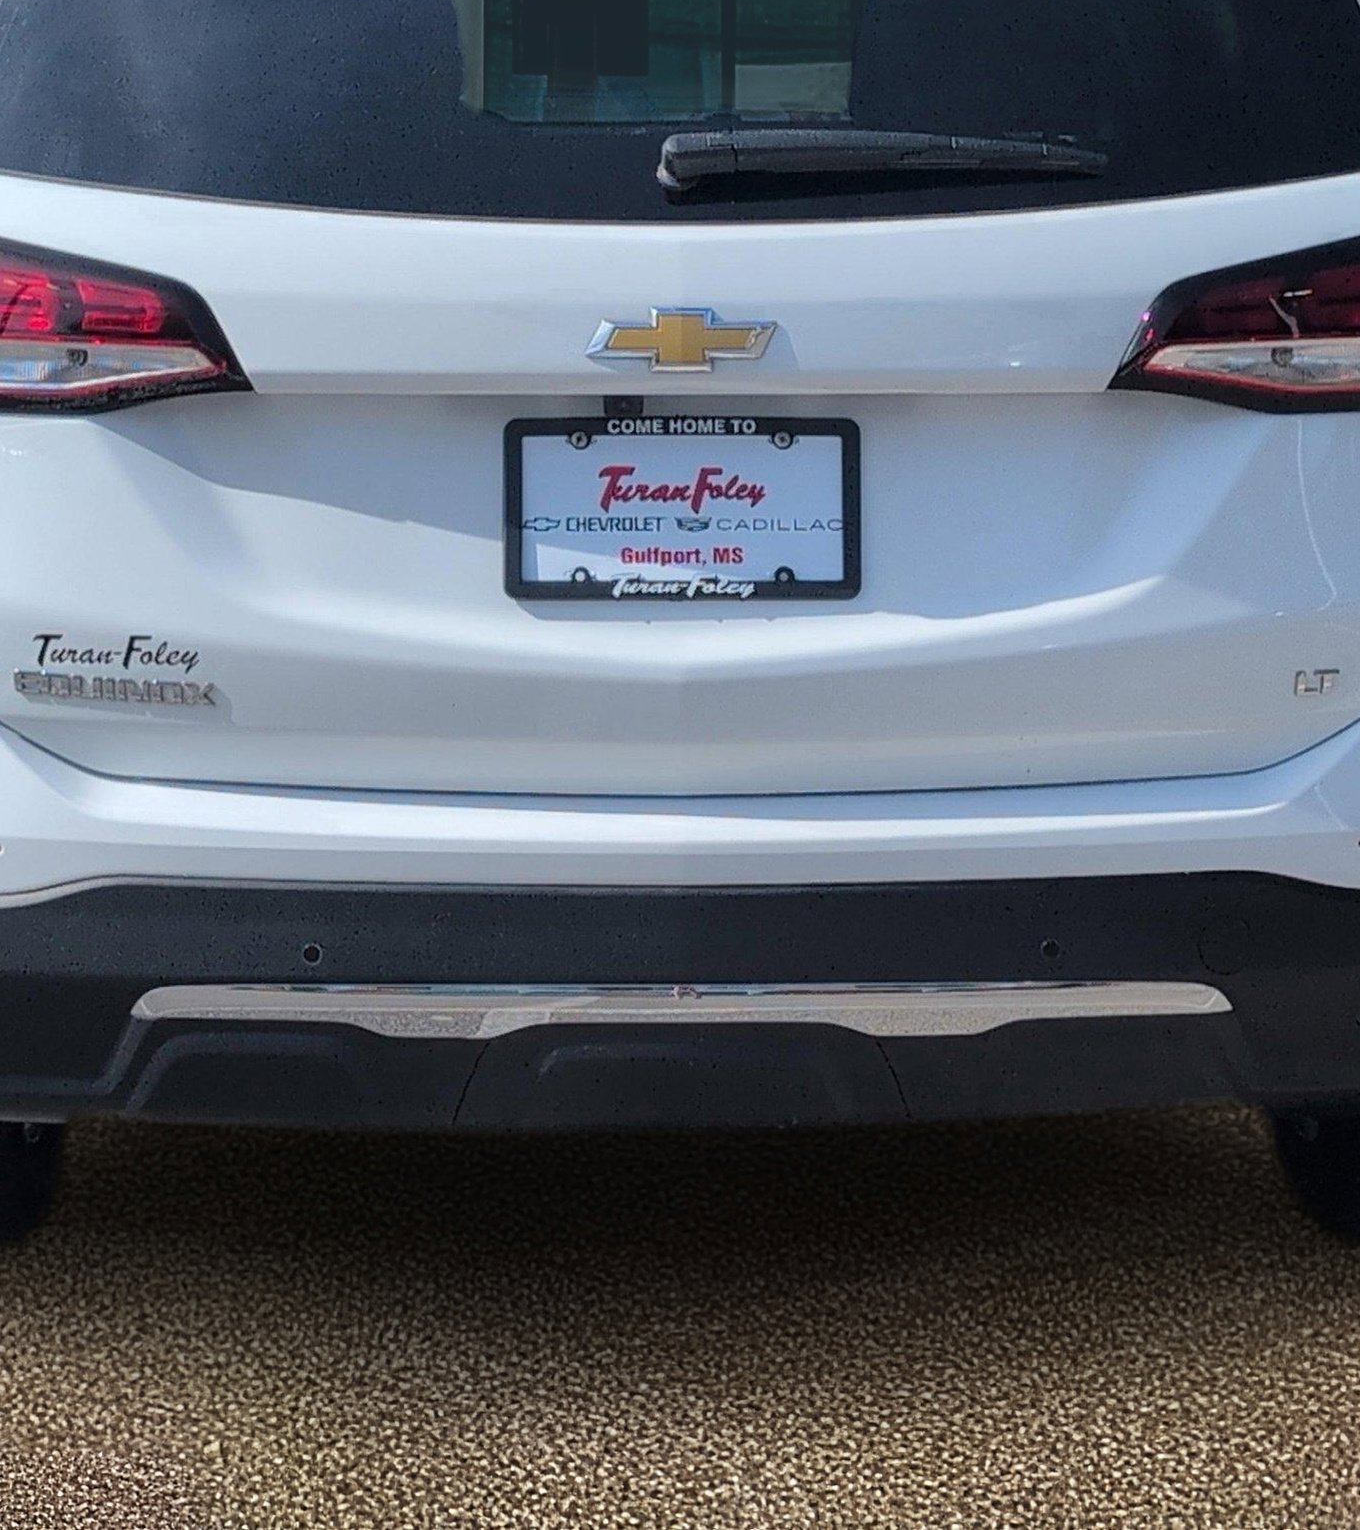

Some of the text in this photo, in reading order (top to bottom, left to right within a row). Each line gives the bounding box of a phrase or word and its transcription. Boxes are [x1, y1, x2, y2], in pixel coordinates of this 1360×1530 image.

[607, 419, 757, 435] COME HOME TO
[598, 465, 767, 515] Turan Foley
[565, 516, 844, 533] CHEVROLET CADILLAC
[621, 547, 744, 567] Gulfport, MS
[32, 633, 200, 674] Turan-Foley
[13, 669, 218, 708] EQUINOX
[1293, 668, 1340, 698] LT
